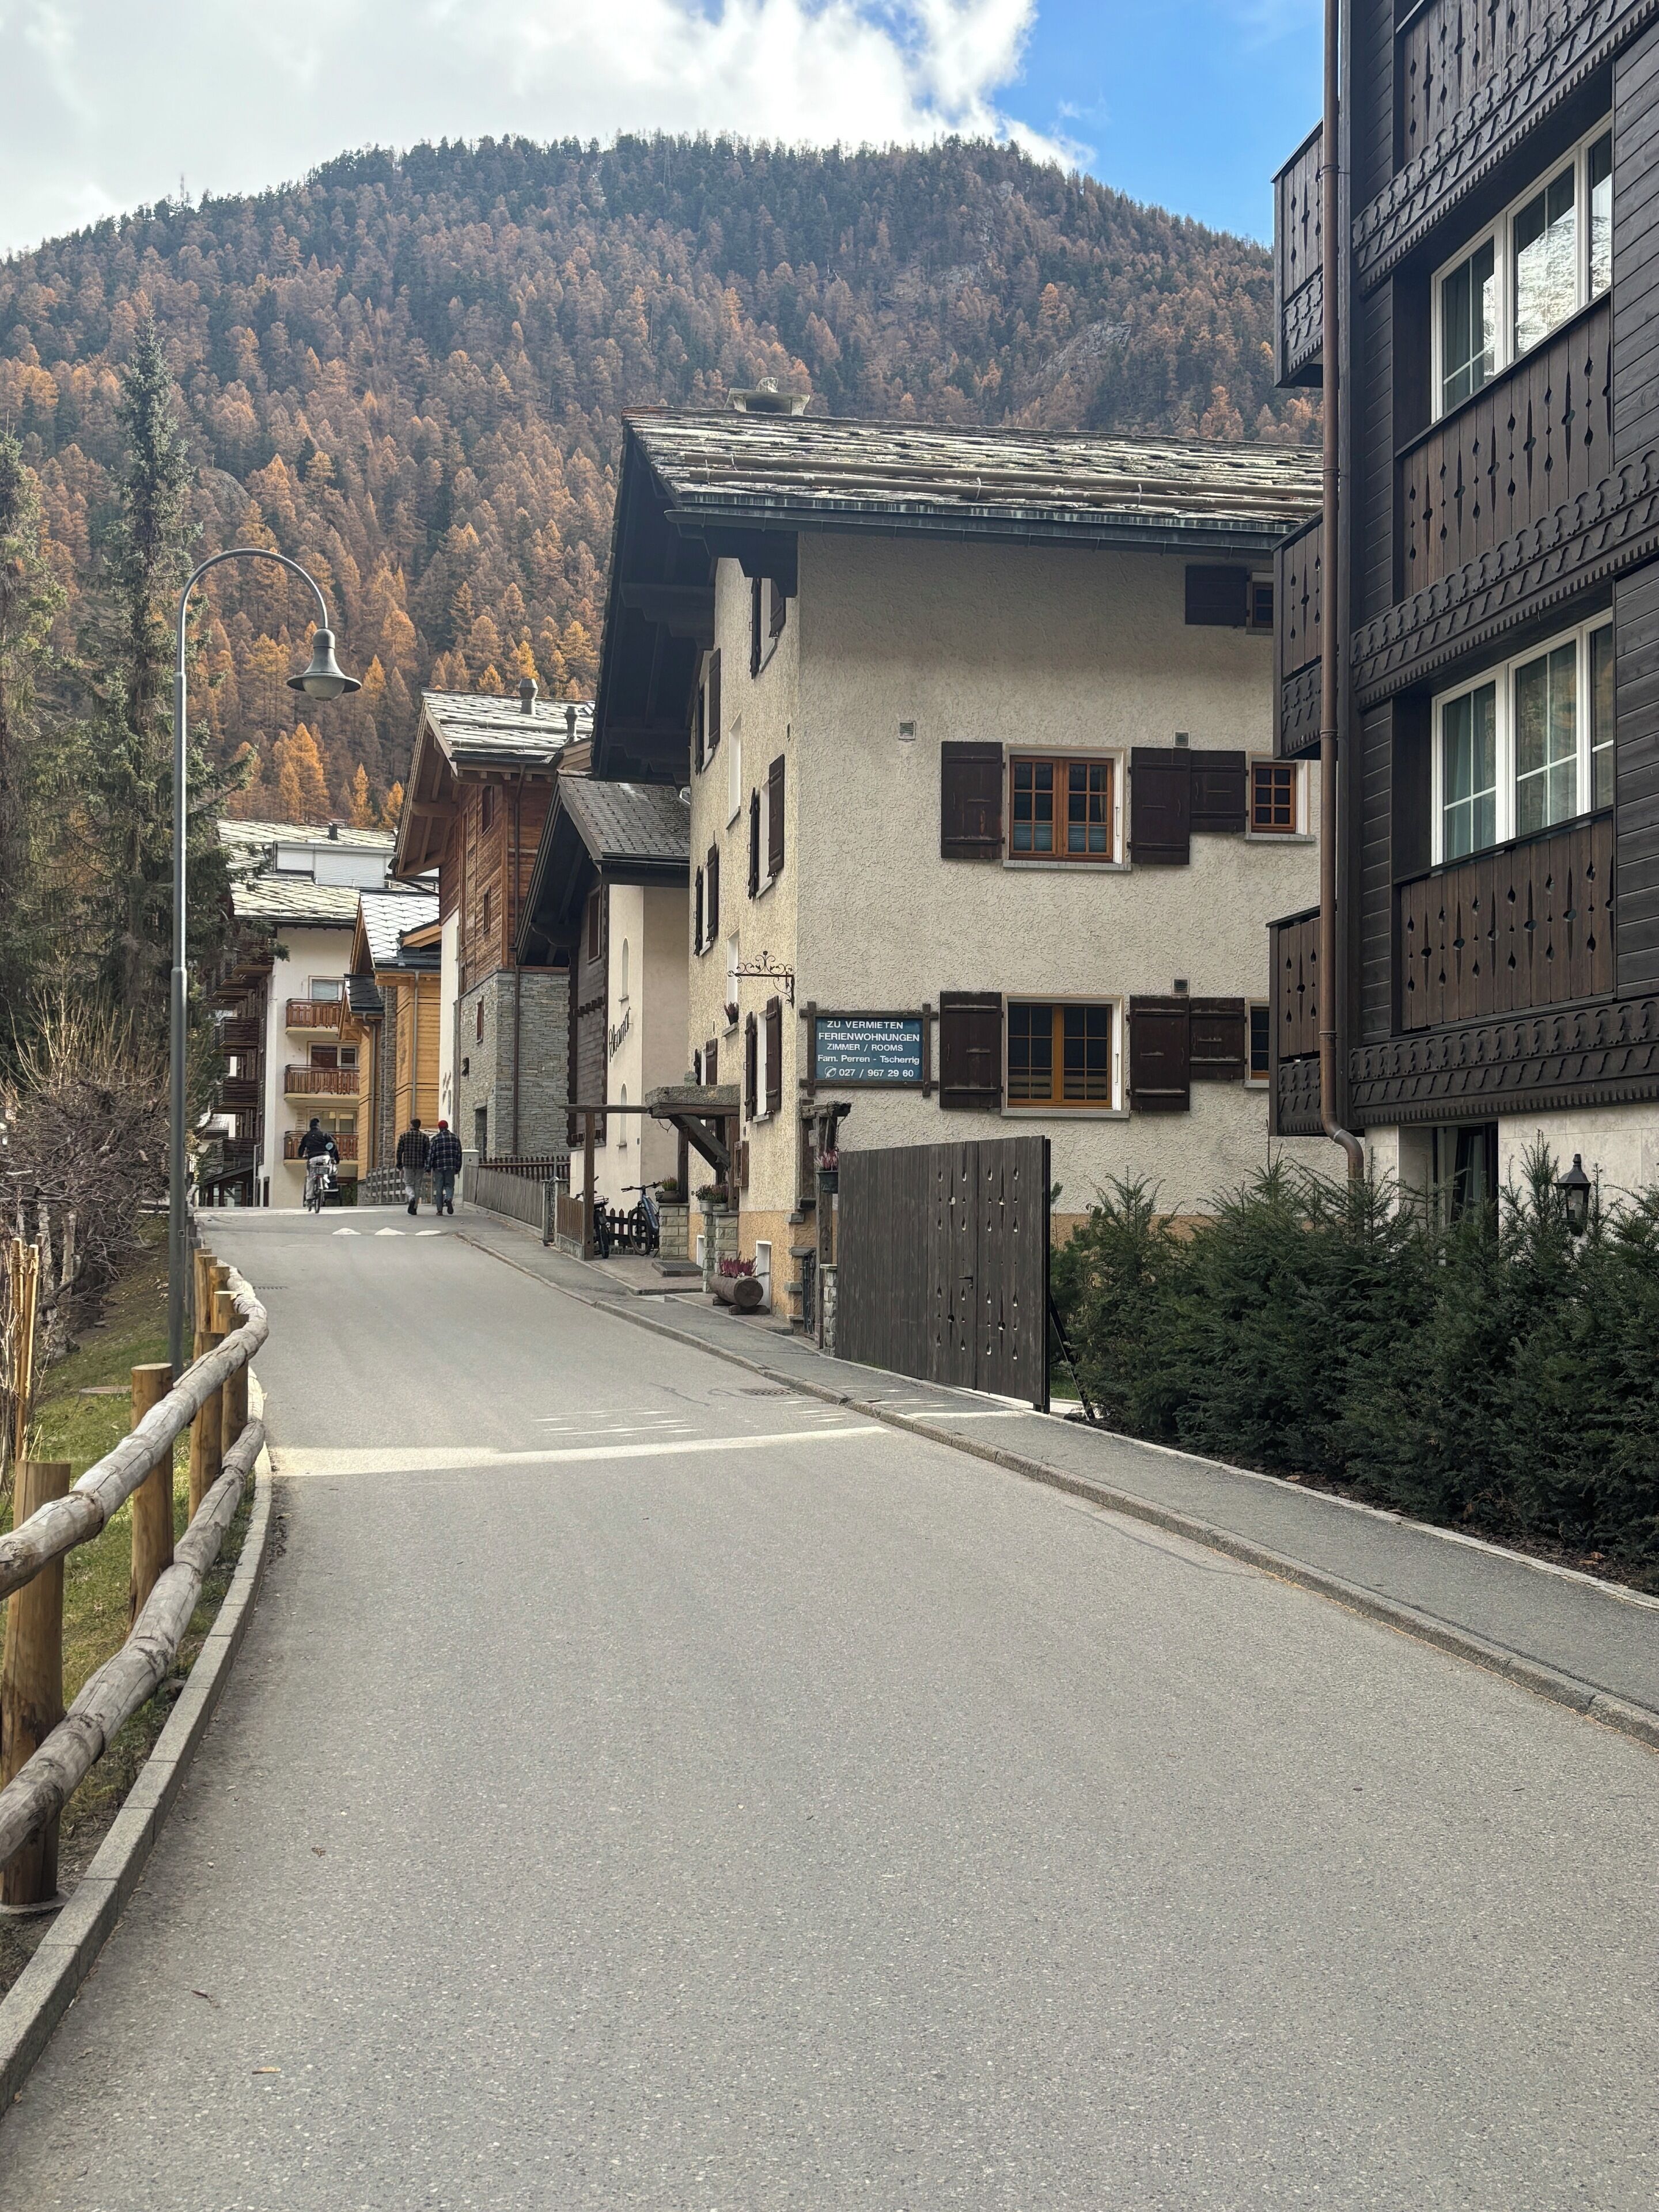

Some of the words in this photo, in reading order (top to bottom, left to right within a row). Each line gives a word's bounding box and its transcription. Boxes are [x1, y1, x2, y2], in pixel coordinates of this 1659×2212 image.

[819, 1032, 919, 1041] FERIENWOHNUNGEN
[863, 1044, 868, 1052] /
[880, 1055, 919, 1065] Tscherrig
[839, 1069, 855, 1077] 027
[859, 1069, 864, 1078] /
